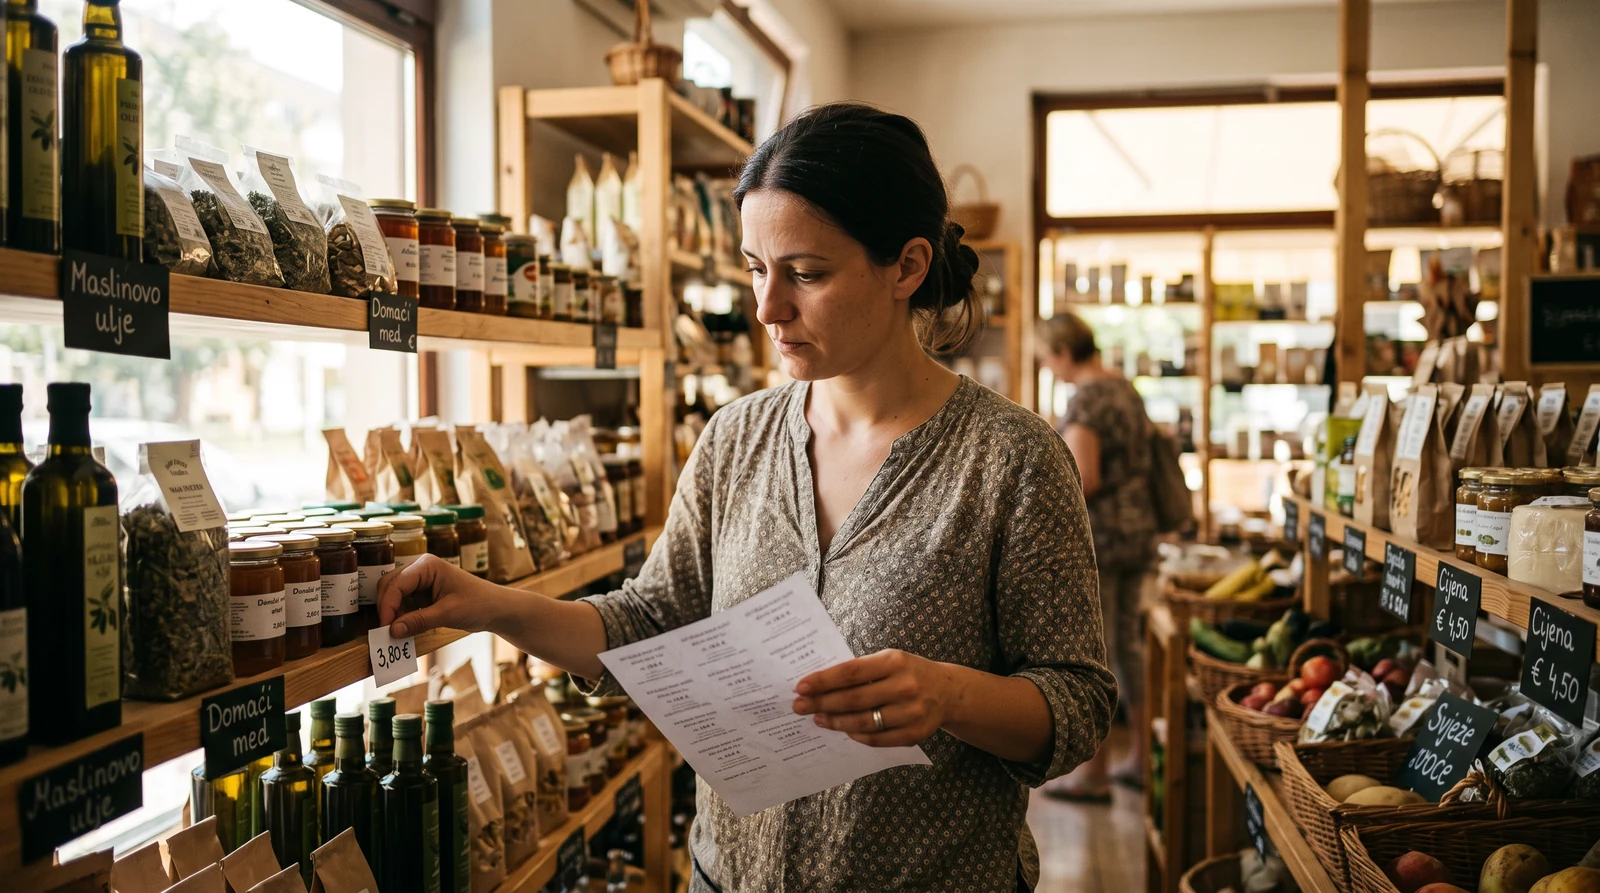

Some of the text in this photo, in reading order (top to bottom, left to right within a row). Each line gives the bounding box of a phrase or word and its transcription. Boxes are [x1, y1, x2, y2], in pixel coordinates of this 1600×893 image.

[71, 260, 161, 304] Maslinovo
[95, 304, 136, 345] ulje
[372, 297, 412, 322] Domaći
[379, 323, 416, 350] med €
[1439, 567, 1469, 605] Cijena
[1436, 608, 1469, 642] € 4,50
[1532, 606, 1575, 652] Cijena
[376, 641, 411, 669] 3,80€
[1531, 657, 1580, 704] € 4,50
[206, 685, 273, 733] Domaći
[1428, 703, 1475, 747] Svježe
[232, 717, 270, 757] med
[69, 794, 115, 834] ulje
